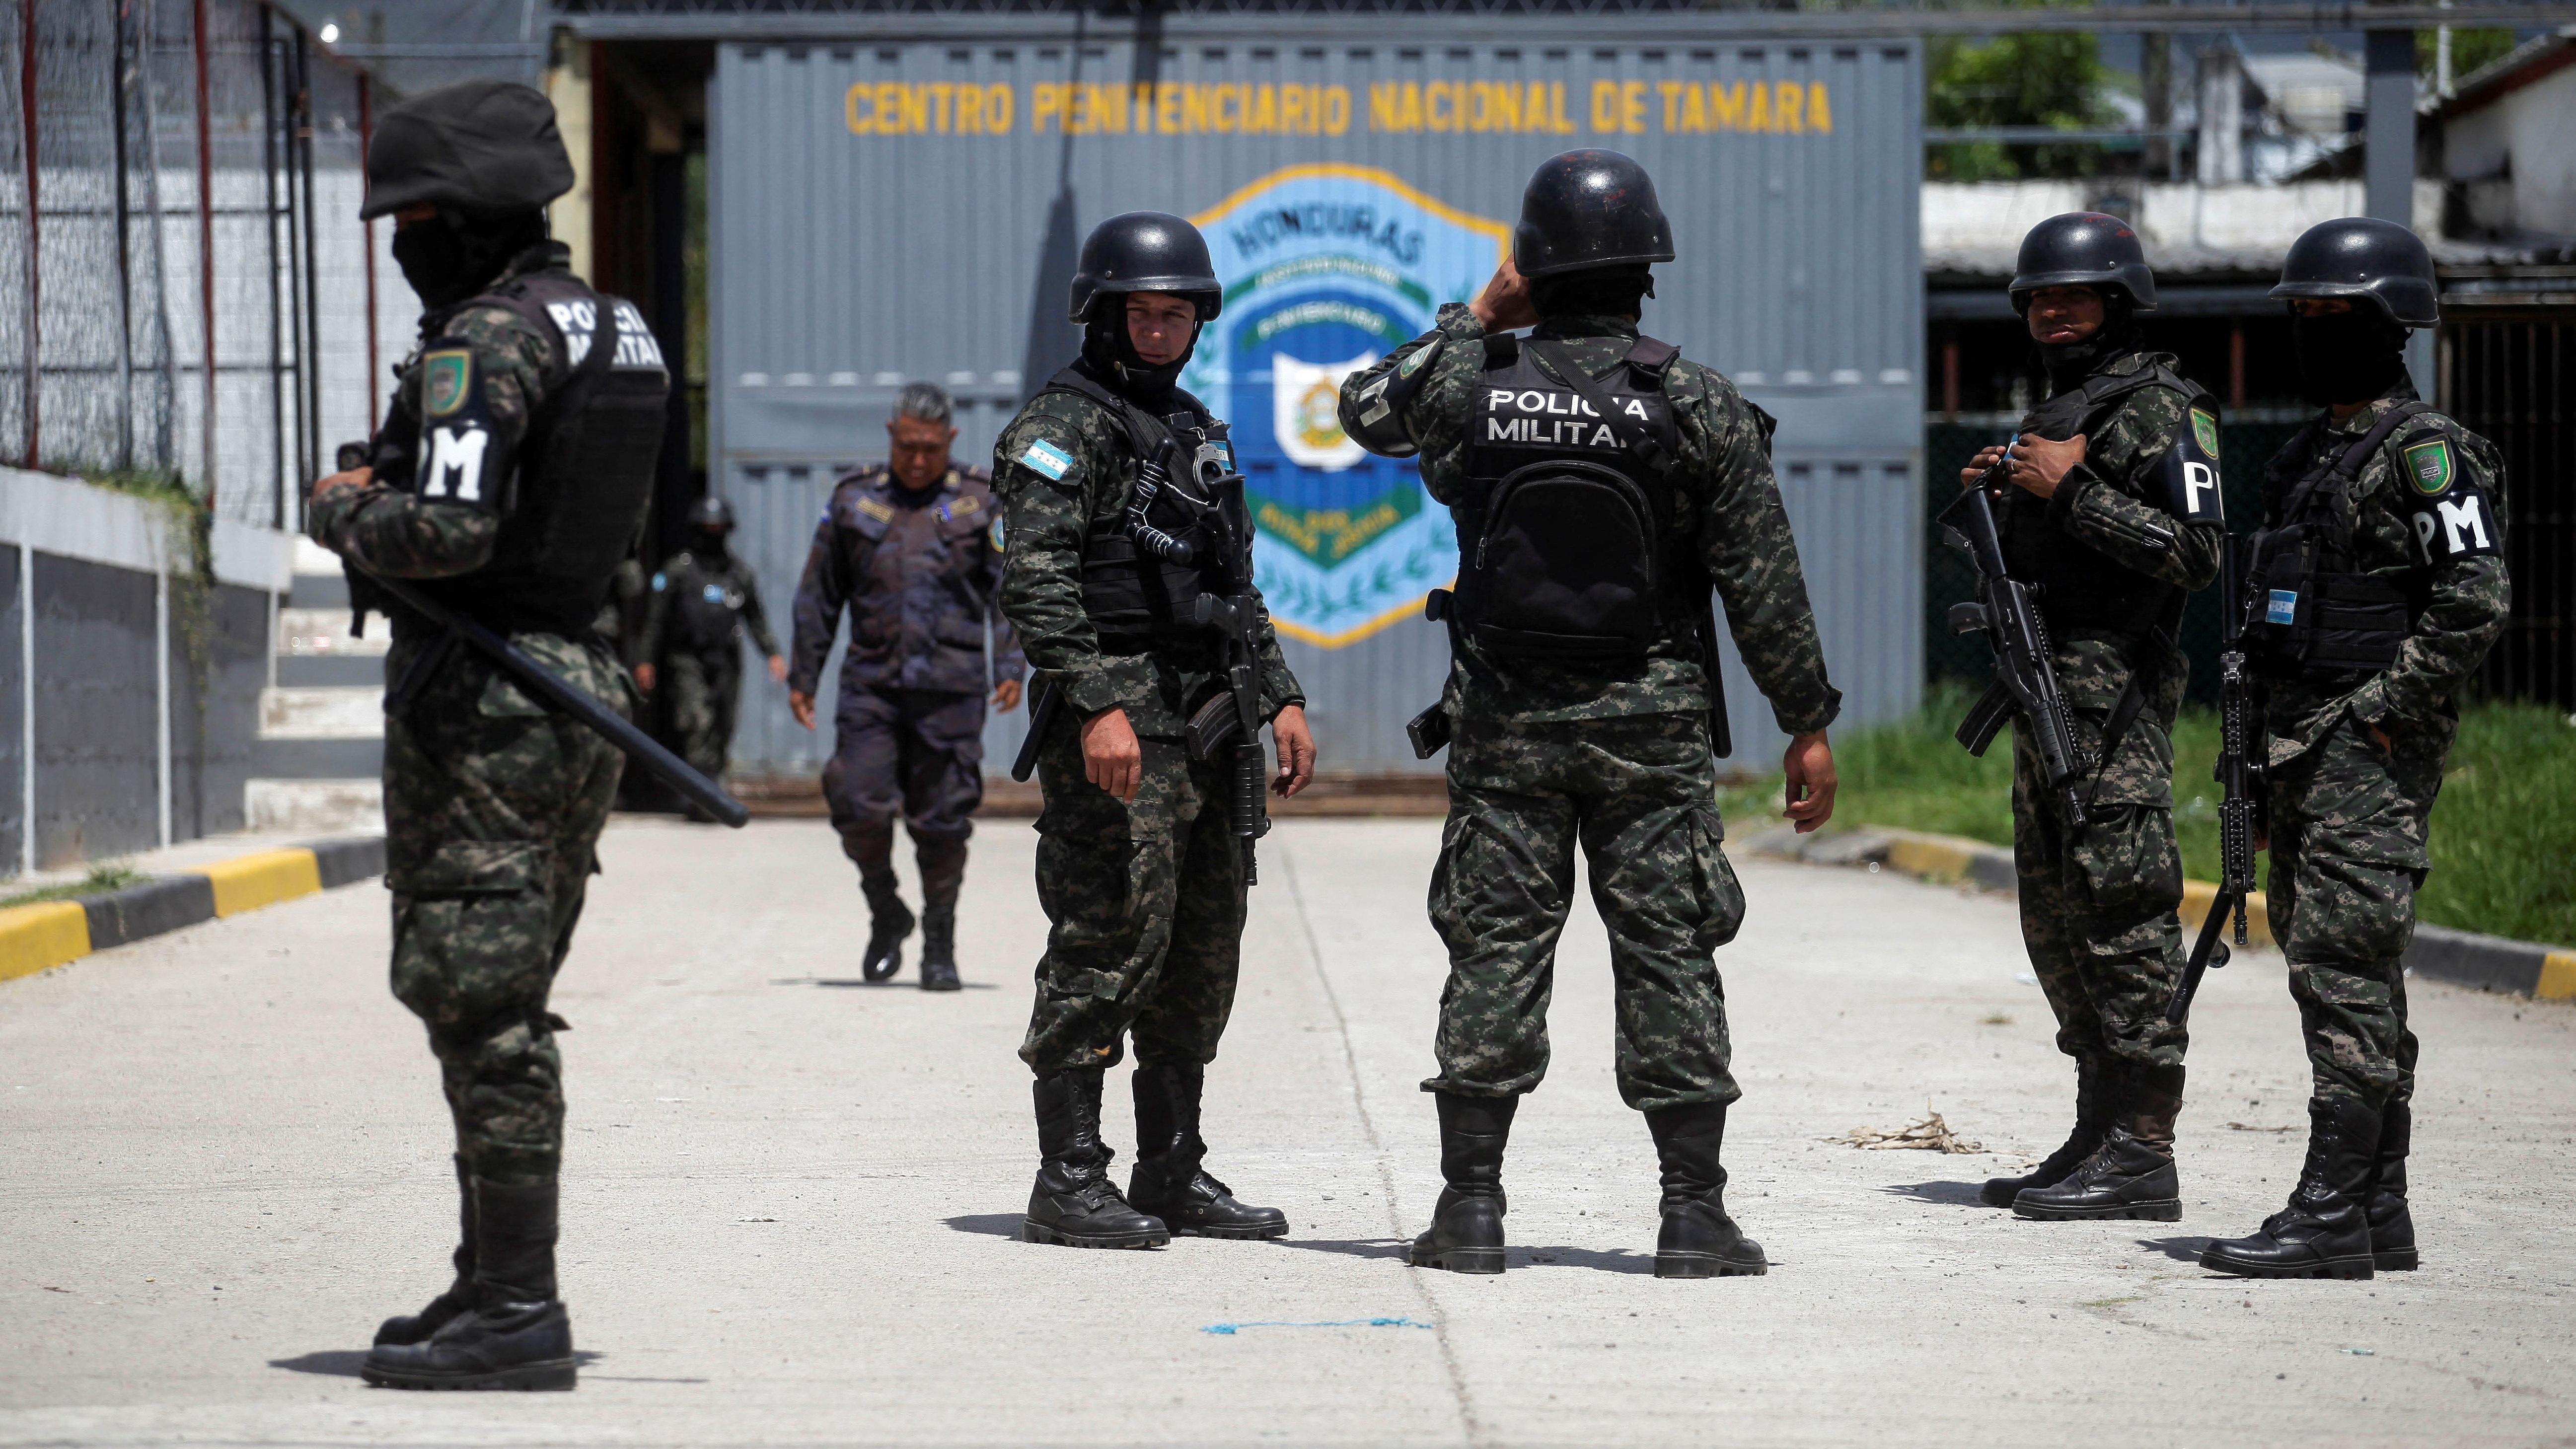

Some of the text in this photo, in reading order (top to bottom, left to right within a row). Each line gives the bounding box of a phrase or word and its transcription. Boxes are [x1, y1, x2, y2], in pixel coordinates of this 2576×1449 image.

[845, 80, 1833, 135] CENTRO PENITENCIARIO NACIONAL DE TAMARA
[1230, 201, 1424, 267] HONDURAS
[1488, 417, 1627, 448] MILITA
[1489, 389, 1649, 421] POLICA
[2412, 496, 2491, 567] PM
